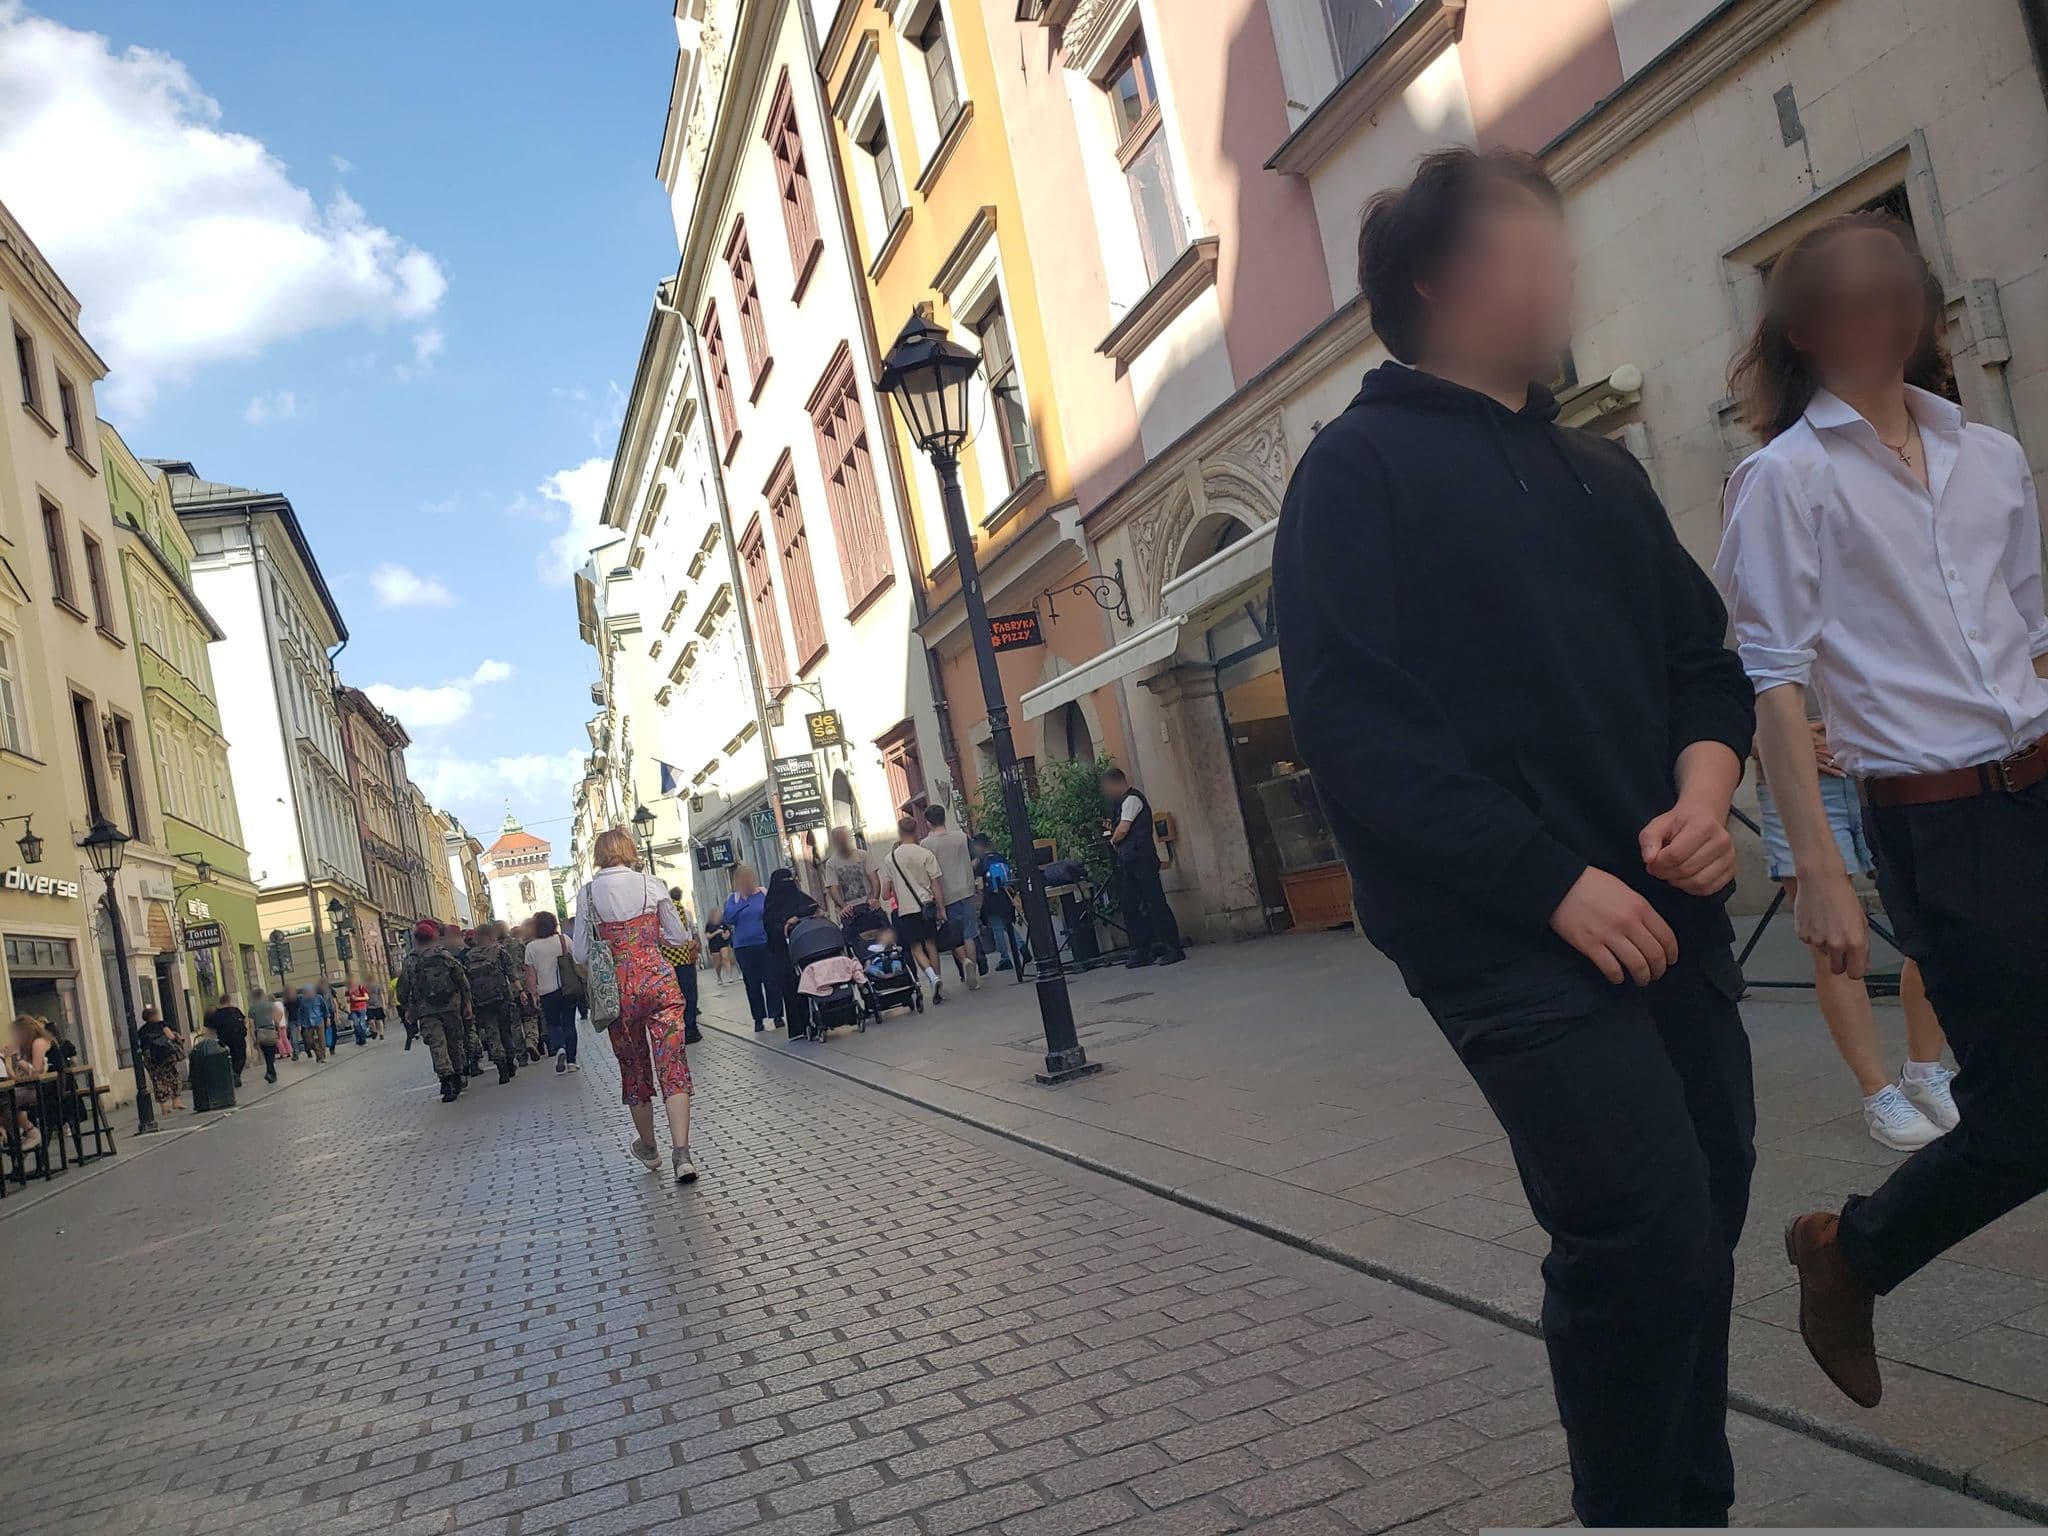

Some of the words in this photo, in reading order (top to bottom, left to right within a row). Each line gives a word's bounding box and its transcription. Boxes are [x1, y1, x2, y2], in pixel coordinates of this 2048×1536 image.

[993, 619, 1035, 634] FABRYKA
[1001, 630, 1030, 644] PIZZY
[5, 865, 78, 898] diverse
